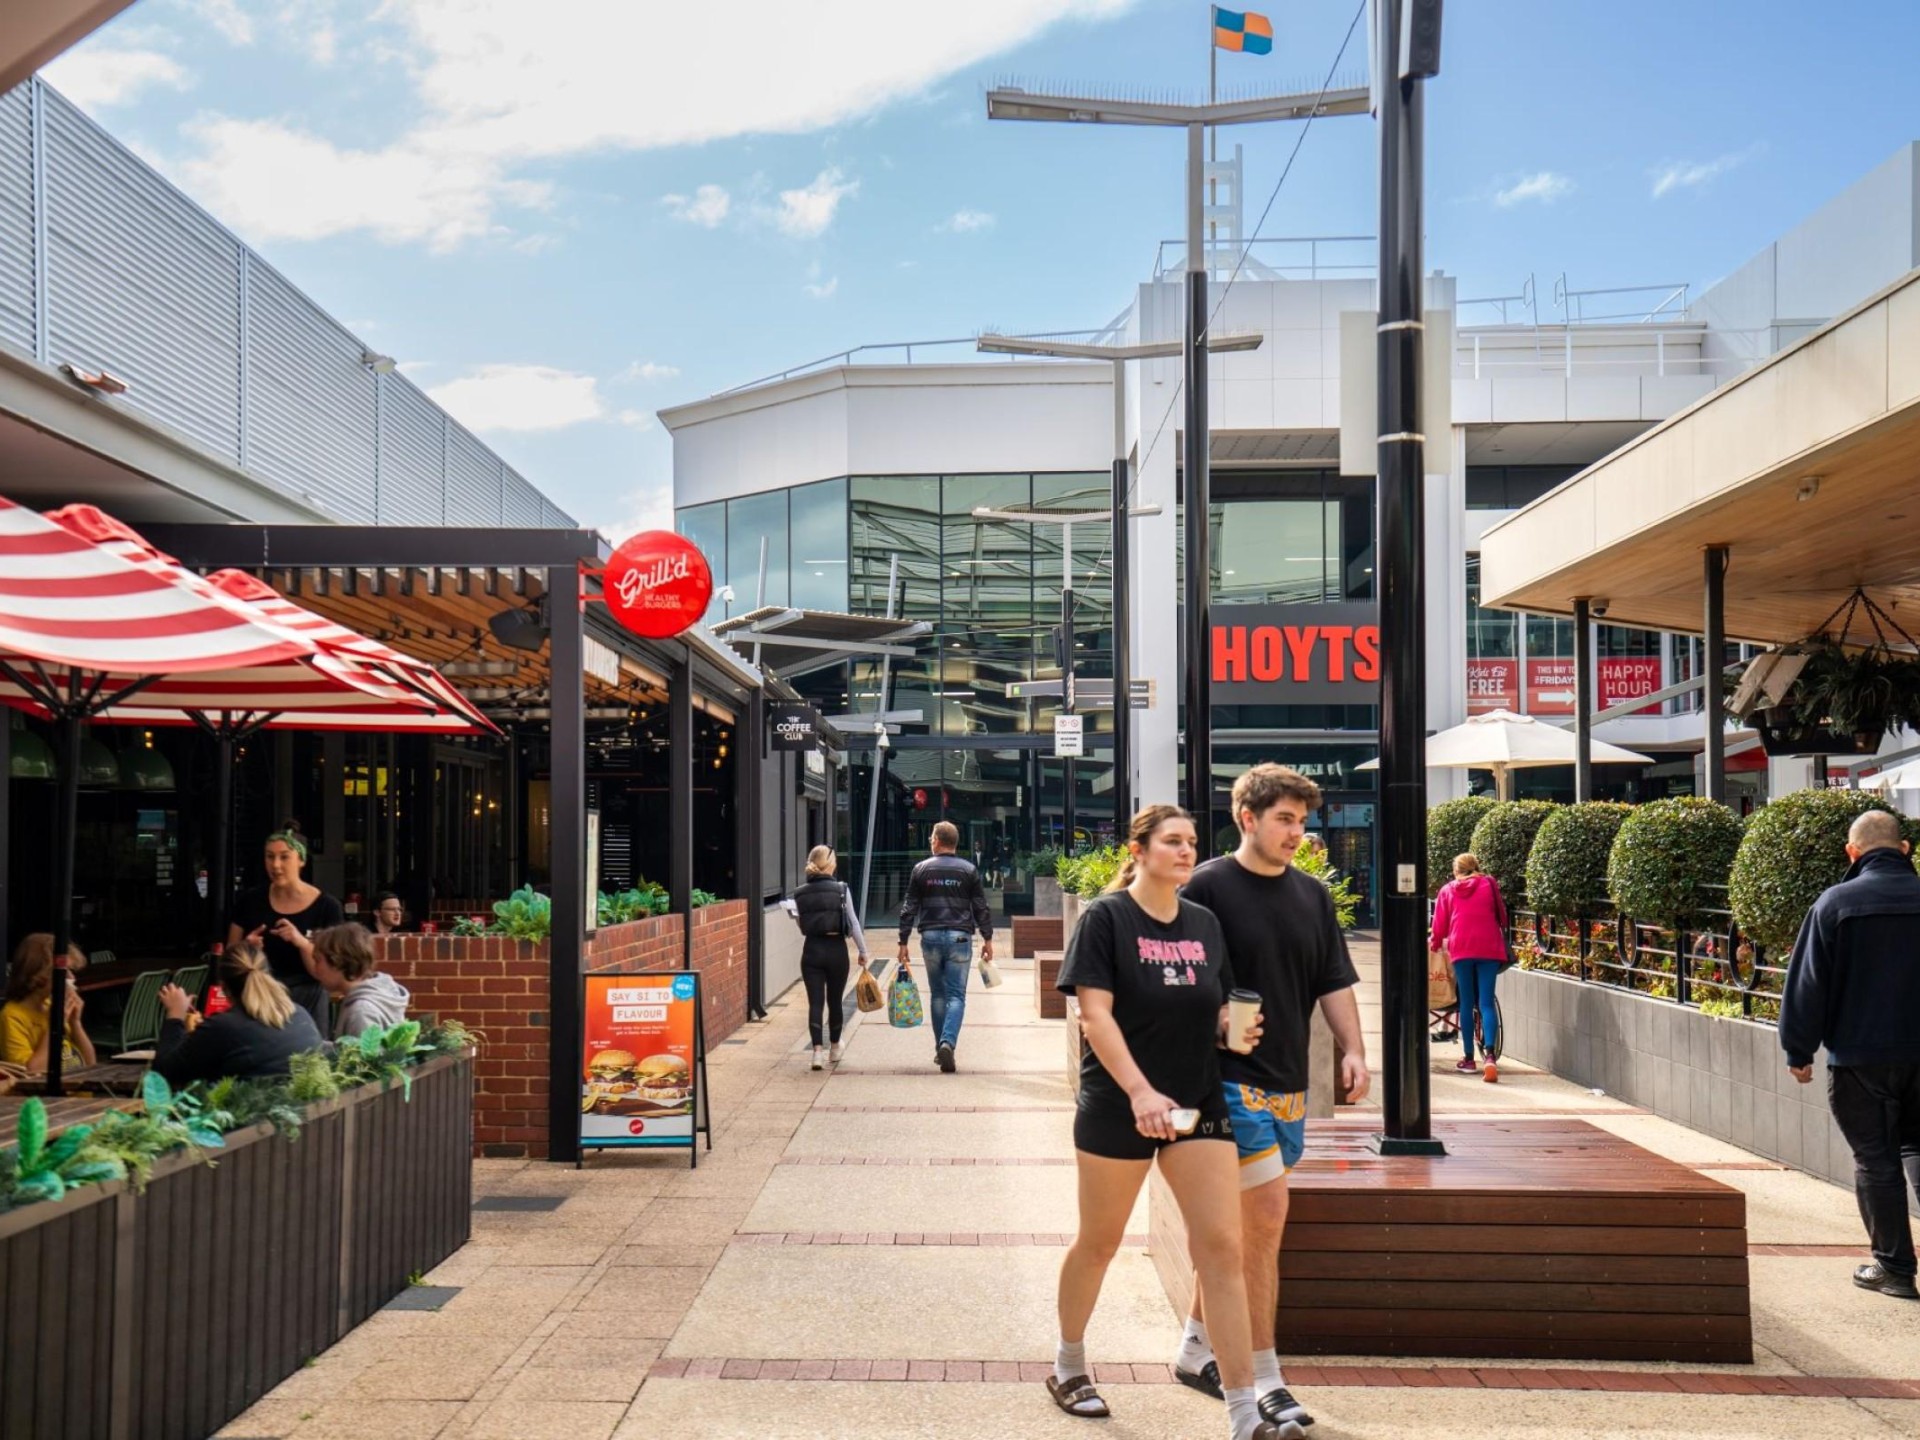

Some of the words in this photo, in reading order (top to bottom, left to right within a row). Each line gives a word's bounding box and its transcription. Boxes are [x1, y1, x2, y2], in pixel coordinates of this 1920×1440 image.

[613, 553, 690, 608] Grill'd
[644, 601, 682, 609] BURGERS
[1212, 625, 1380, 682] HOYTS
[1537, 665, 1551, 674] THIS
[1554, 665, 1566, 674] WAY
[1602, 665, 1654, 679] HAPPY
[1469, 679, 1505, 695] FREE
[1605, 681, 1653, 695] HOUR
[776, 723, 812, 732] COFFEE
[784, 733, 803, 741] CLUB
[611, 993, 631, 1002] SAY
[637, 992, 649, 1001] SI
[657, 991, 670, 1000] TO
[616, 1009, 663, 1019] FLAVOUR
